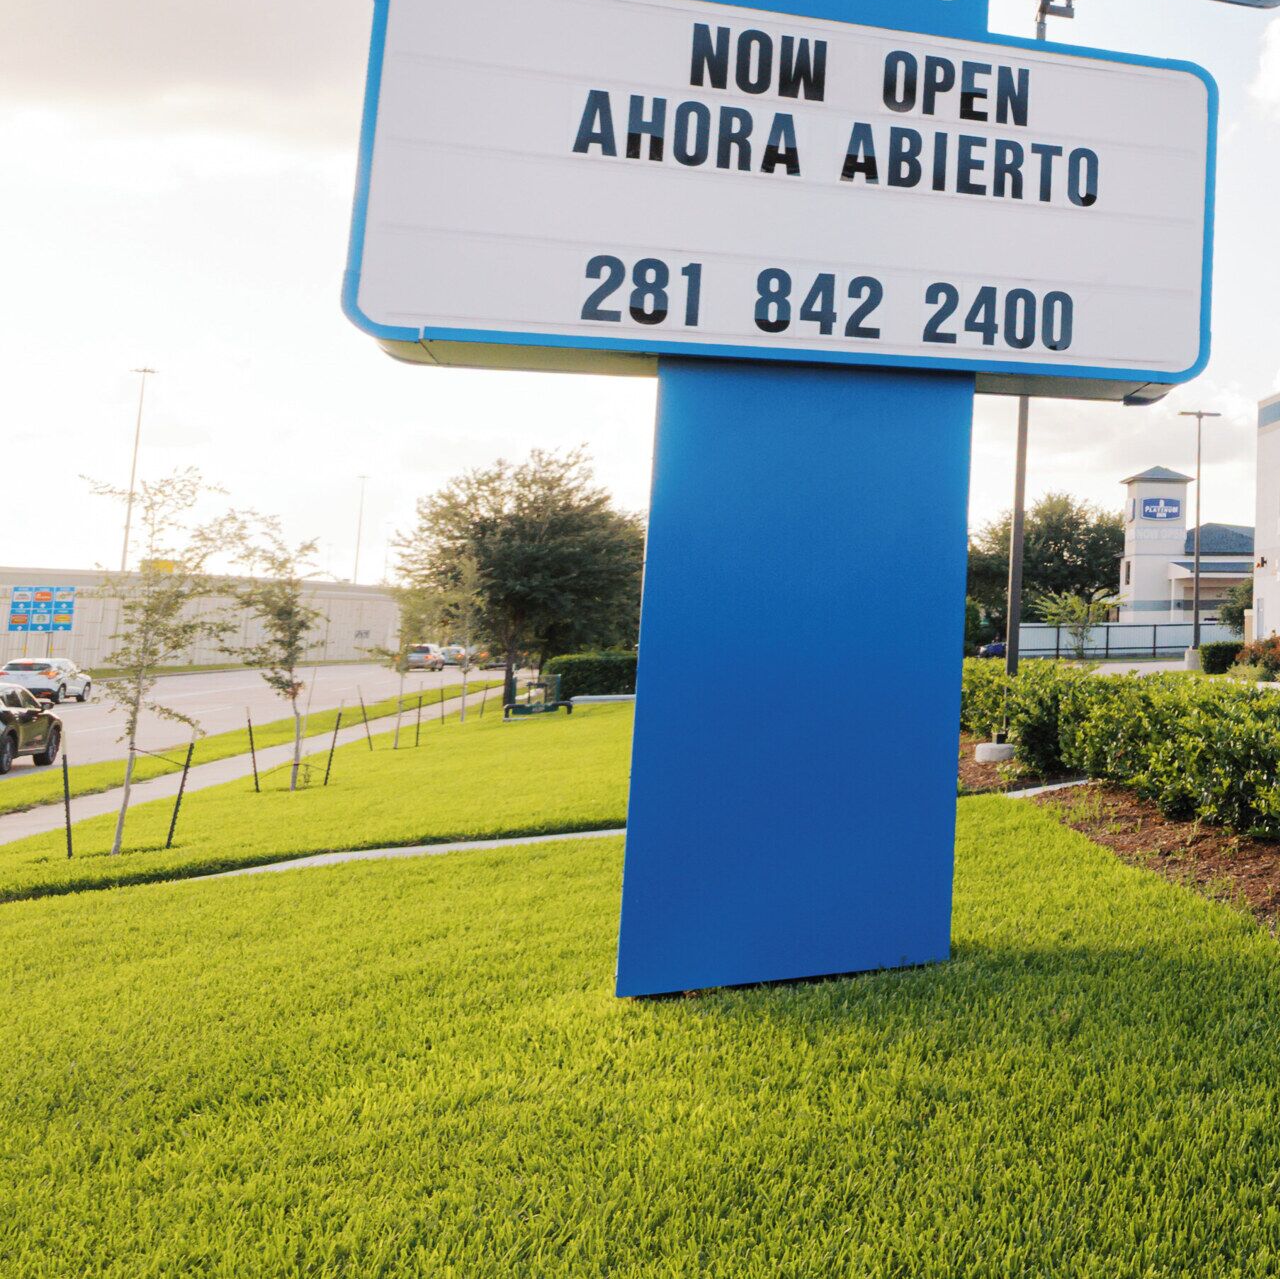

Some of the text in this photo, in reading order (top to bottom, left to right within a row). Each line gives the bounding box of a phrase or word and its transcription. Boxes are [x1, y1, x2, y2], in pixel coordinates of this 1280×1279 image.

[690, 22, 1030, 127] NOW OPEN
[572, 89, 1100, 207] AHORA ABIERTO
[581, 254, 1074, 352] 281 842 2400
